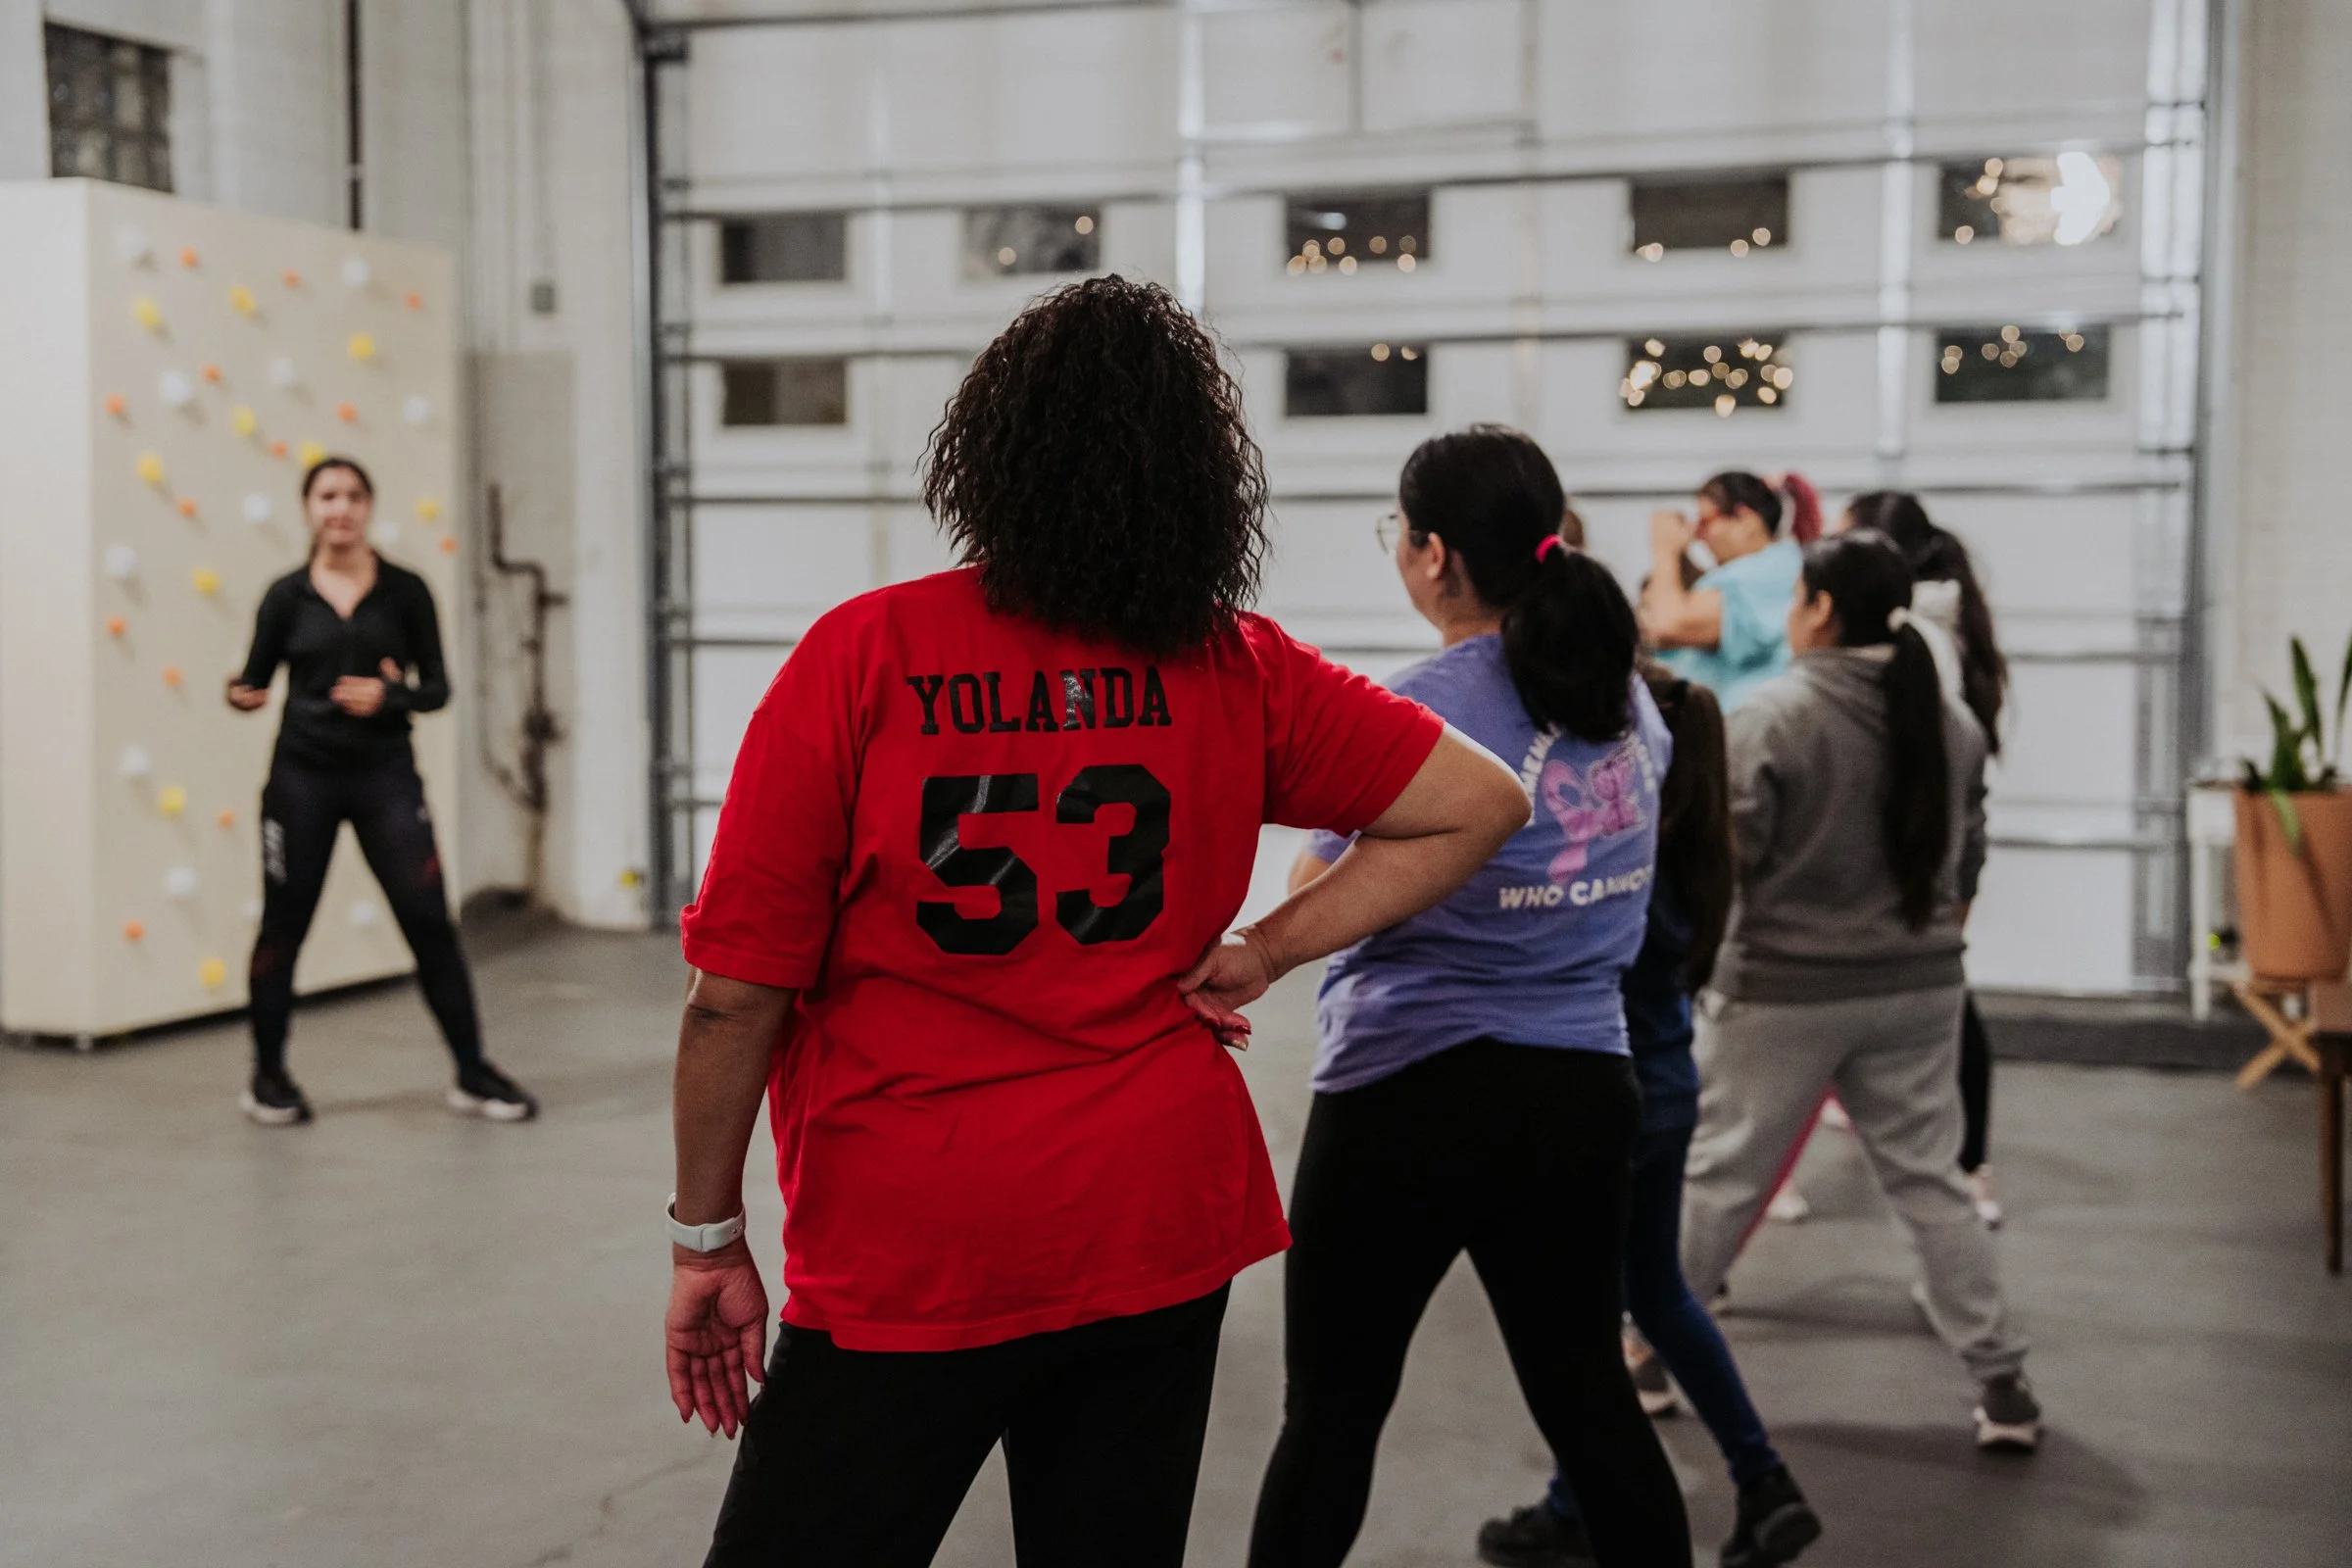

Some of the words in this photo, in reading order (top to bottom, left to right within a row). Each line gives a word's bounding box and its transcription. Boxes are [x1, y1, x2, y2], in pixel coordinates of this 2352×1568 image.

[906, 665, 1172, 735] YOLANDA
[916, 763, 1171, 956] 53
[1499, 885, 1564, 909] WHO
